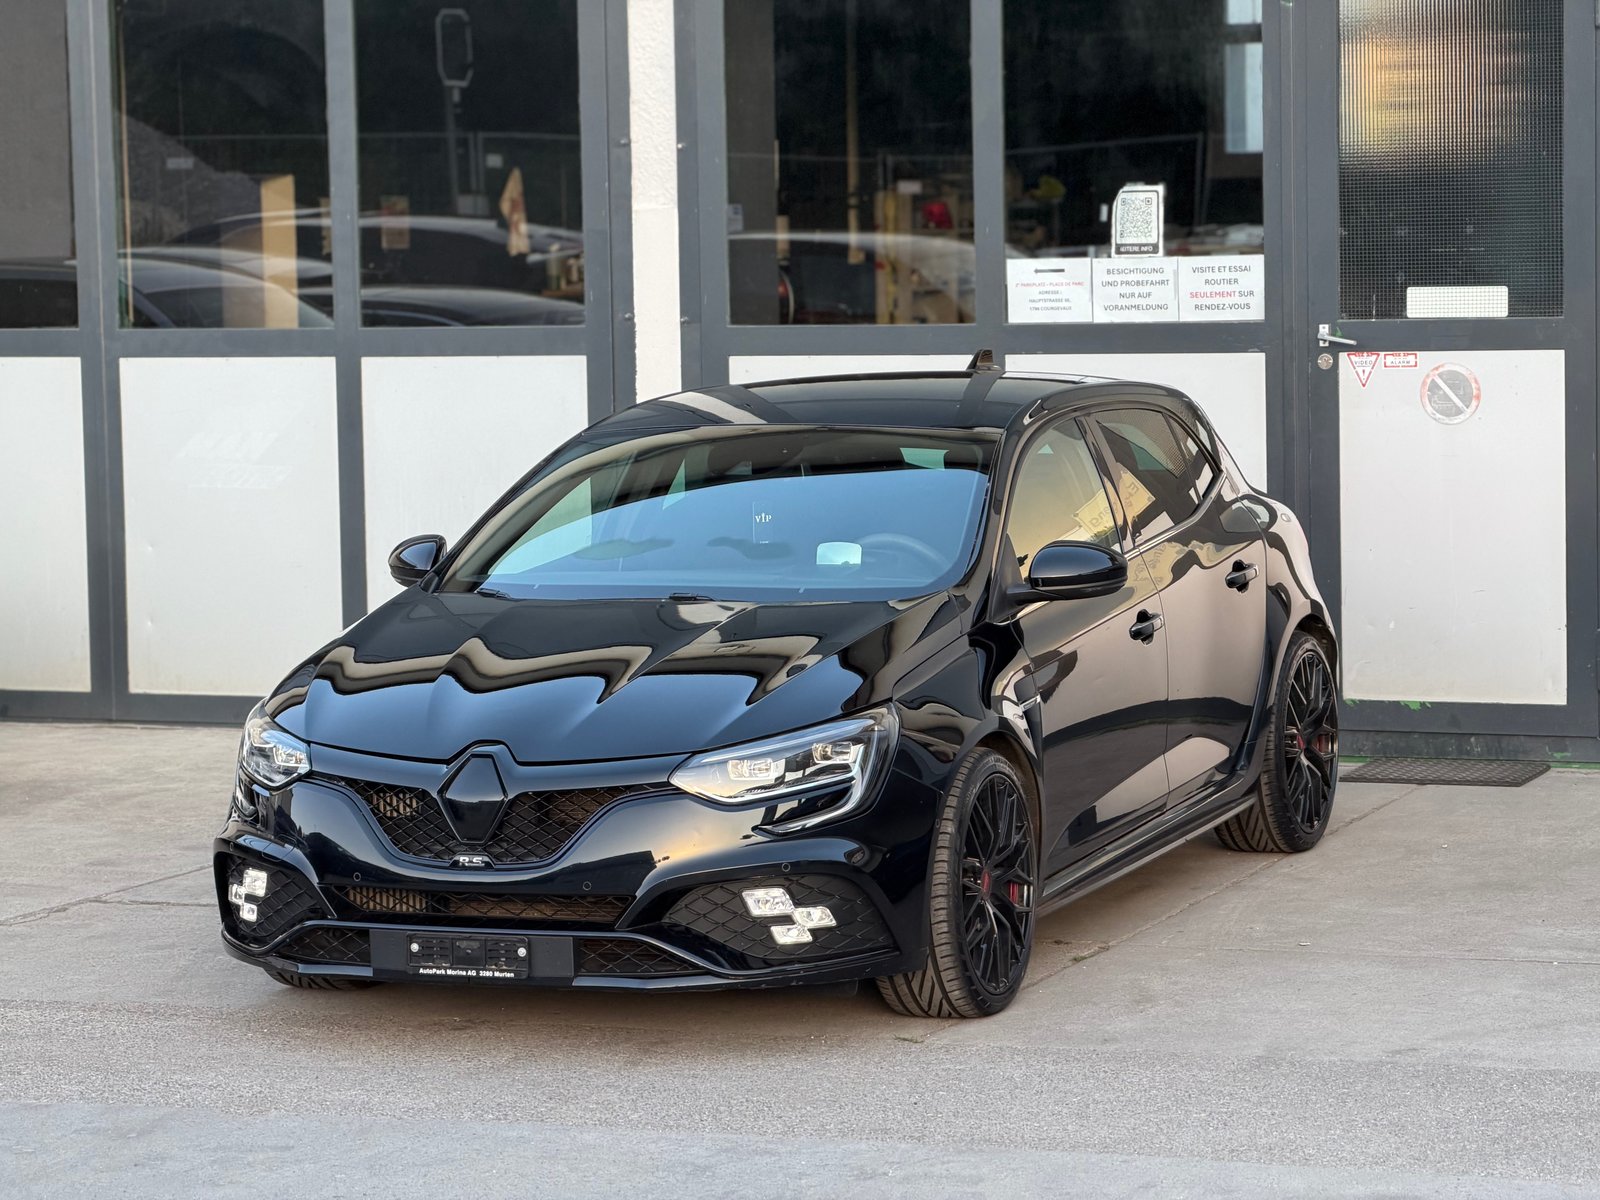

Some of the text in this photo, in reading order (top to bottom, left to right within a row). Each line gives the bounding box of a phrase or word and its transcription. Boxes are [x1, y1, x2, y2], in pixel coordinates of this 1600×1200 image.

[1106, 267, 1165, 275] BESICHTIGUNG
[1217, 265, 1227, 273] ET
[1228, 265, 1251, 273] ESSAI
[1120, 279, 1170, 287] PROBEFAHRT
[1204, 278, 1239, 286] ROUTIER
[1137, 291, 1152, 299] AUF
[1189, 290, 1255, 298] SEULEMENT SUR
[1103, 303, 1169, 311] VORANMELDUNG
[1194, 303, 1251, 311] RENDEZ-VOUS
[467, 969, 477, 977] AG
